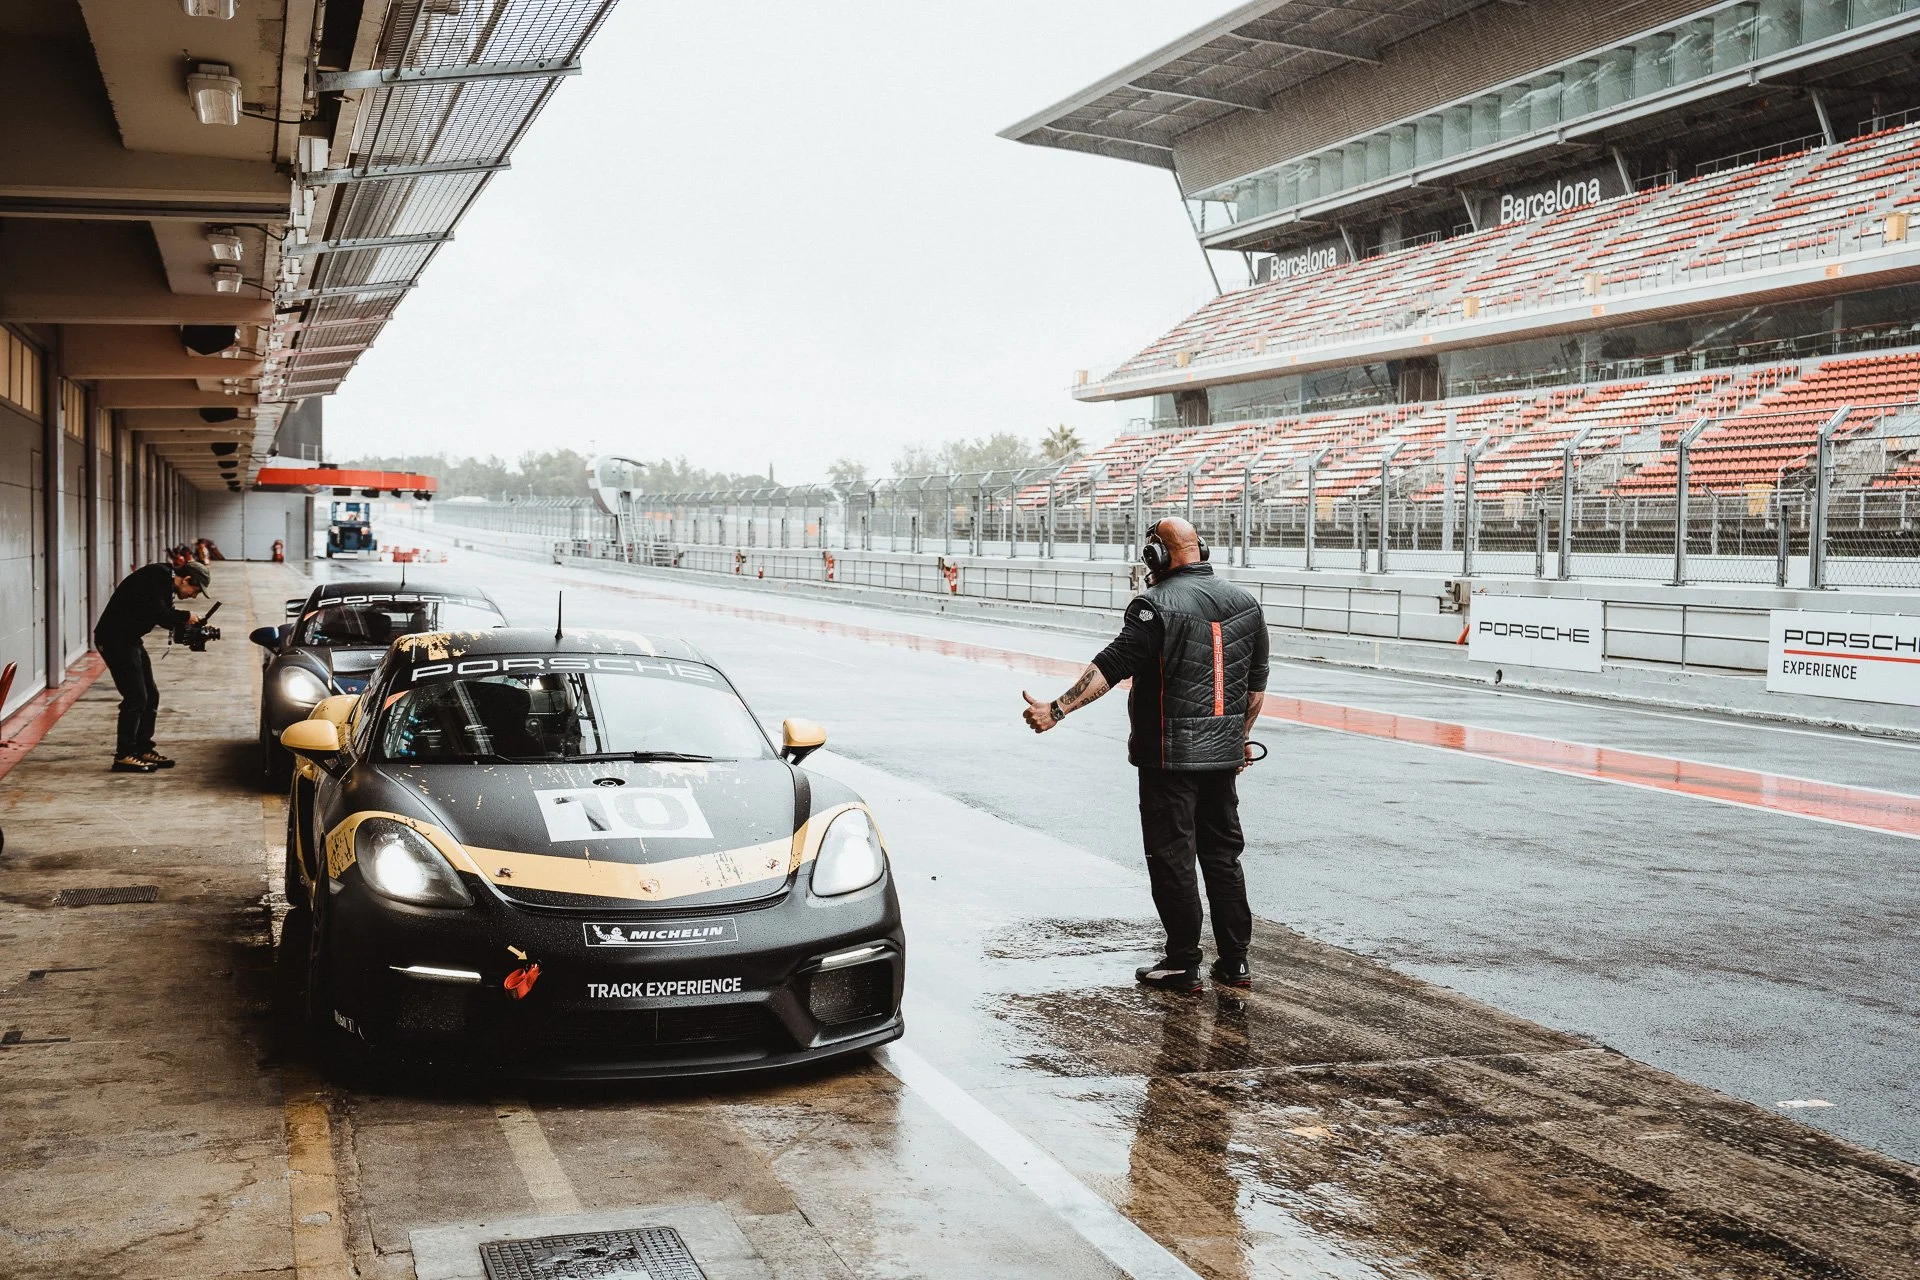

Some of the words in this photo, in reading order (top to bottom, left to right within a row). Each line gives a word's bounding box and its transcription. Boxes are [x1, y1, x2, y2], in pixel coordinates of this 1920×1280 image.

[1500, 178, 1600, 225] Barcelona
[1270, 247, 1337, 281] Barcelona
[317, 594, 491, 610] PORSCHE
[1479, 621, 1590, 644] PORSCHE
[1784, 628, 1920, 653] PORSCH
[410, 656, 717, 683] PORSCHE
[1783, 660, 1858, 680] EXPERIENCE
[553, 791, 690, 832] 10
[629, 926, 724, 940] MICHELIN
[587, 982, 644, 999] TRACK
[646, 977, 742, 997] EXPERIENCE
